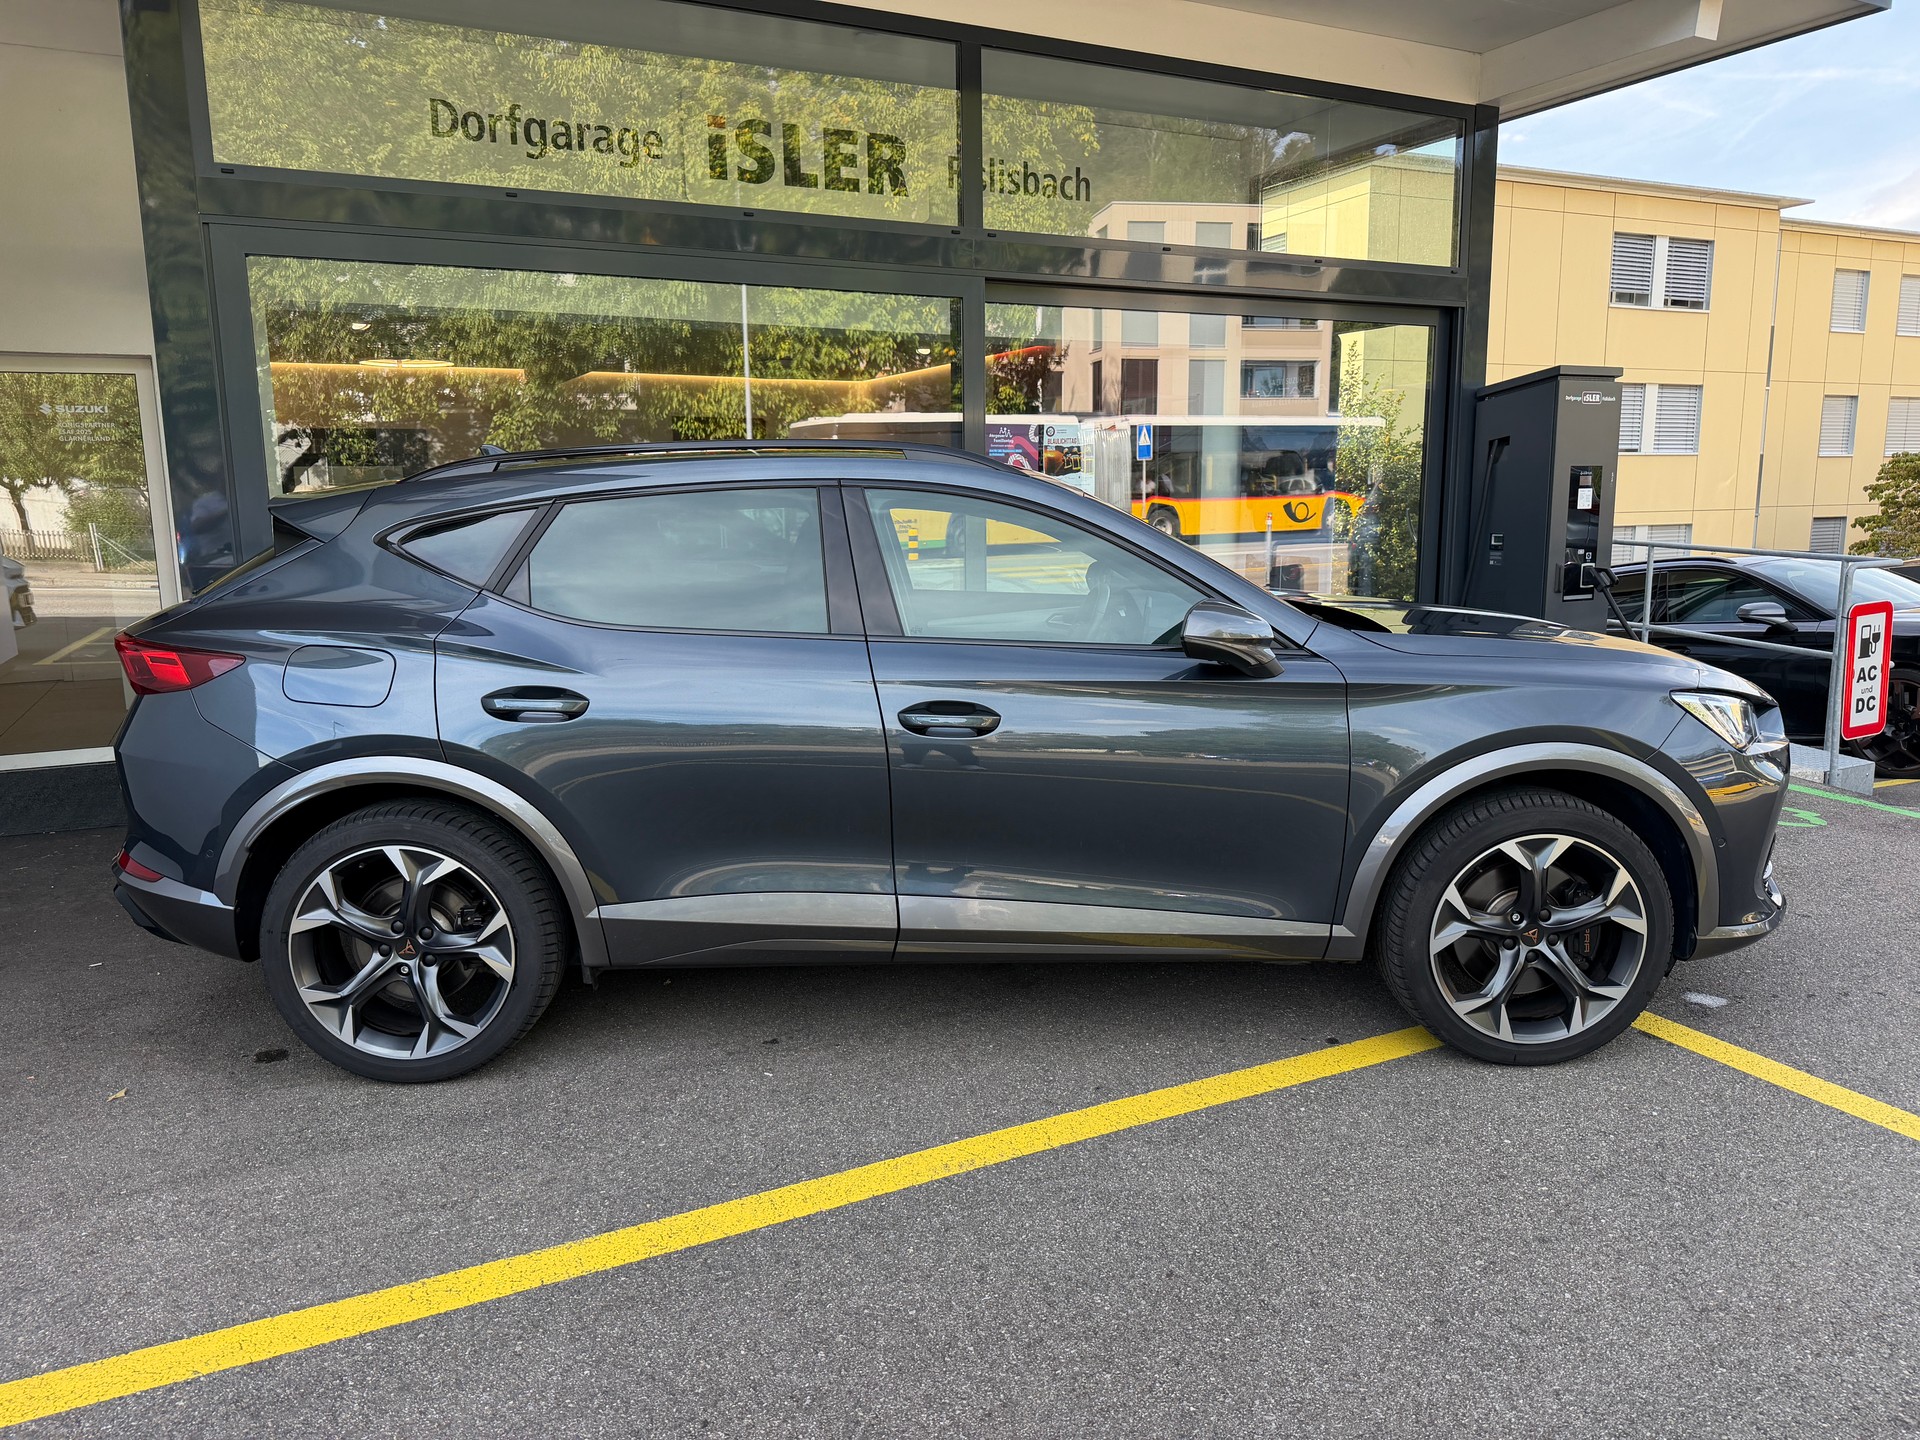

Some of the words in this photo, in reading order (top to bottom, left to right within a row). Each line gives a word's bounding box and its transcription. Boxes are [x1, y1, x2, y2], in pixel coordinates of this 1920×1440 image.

[430, 98, 663, 168] Dorfgarage
[707, 115, 909, 197] iSLER
[948, 155, 1091, 202] Flisbach
[55, 405, 109, 413] SUZUKI
[1856, 665, 1877, 683] AC
[1860, 685, 1873, 694] und
[1855, 696, 1876, 713] DC
